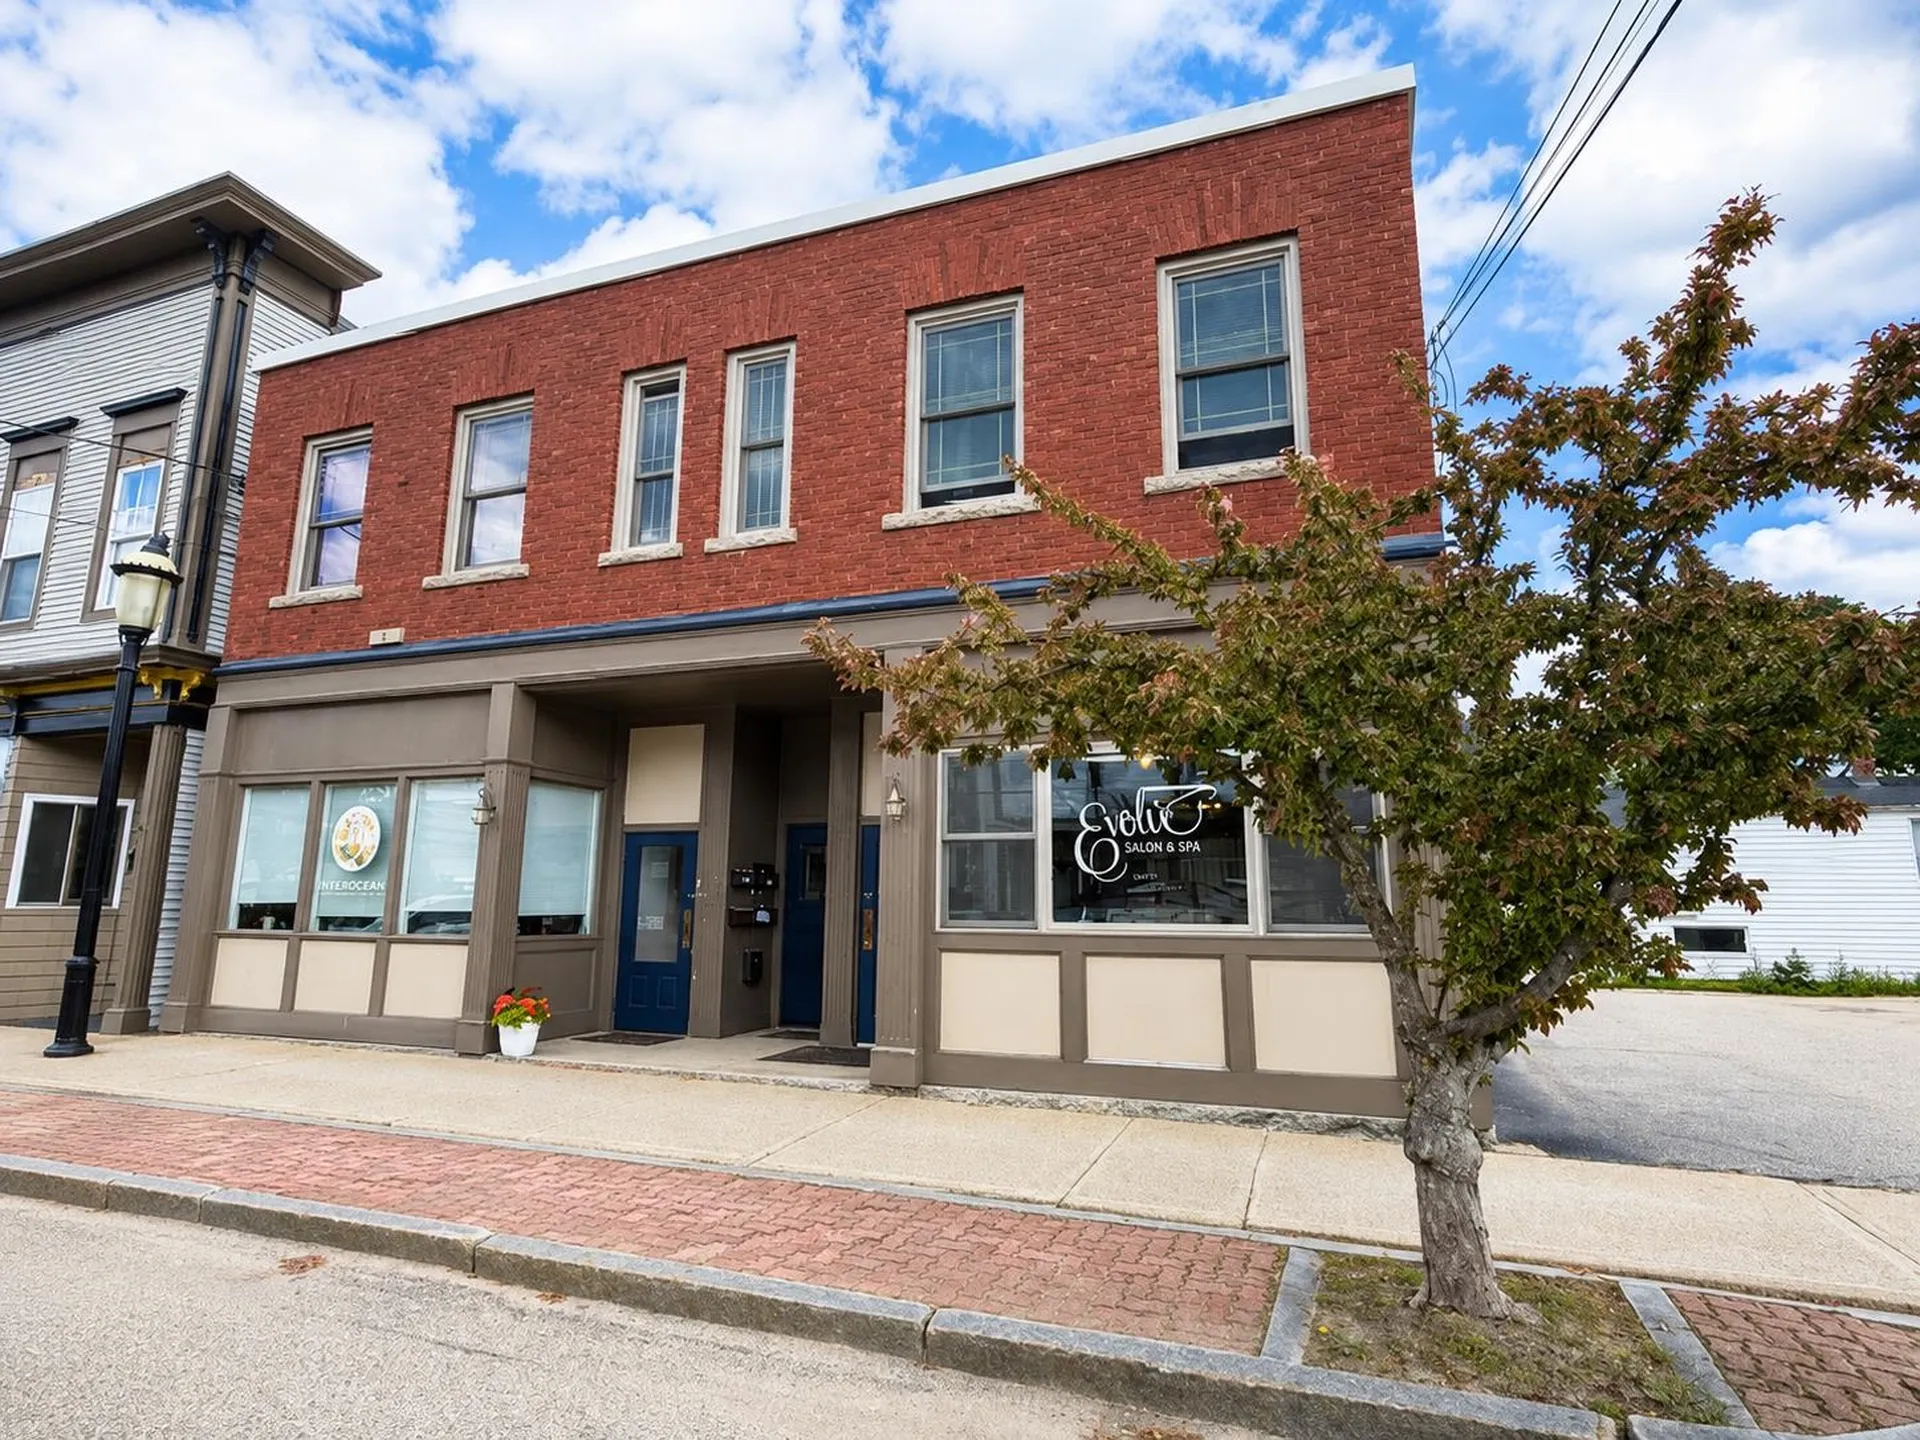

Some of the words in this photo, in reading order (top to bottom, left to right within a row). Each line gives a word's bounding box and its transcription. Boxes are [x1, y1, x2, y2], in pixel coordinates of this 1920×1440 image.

[1074, 784, 1217, 882] Evolve
[1124, 841, 1163, 853] SALON
[1166, 841, 1175, 853] &
[1178, 841, 1201, 853] SPA
[317, 880, 385, 891] INTEROCEAN
